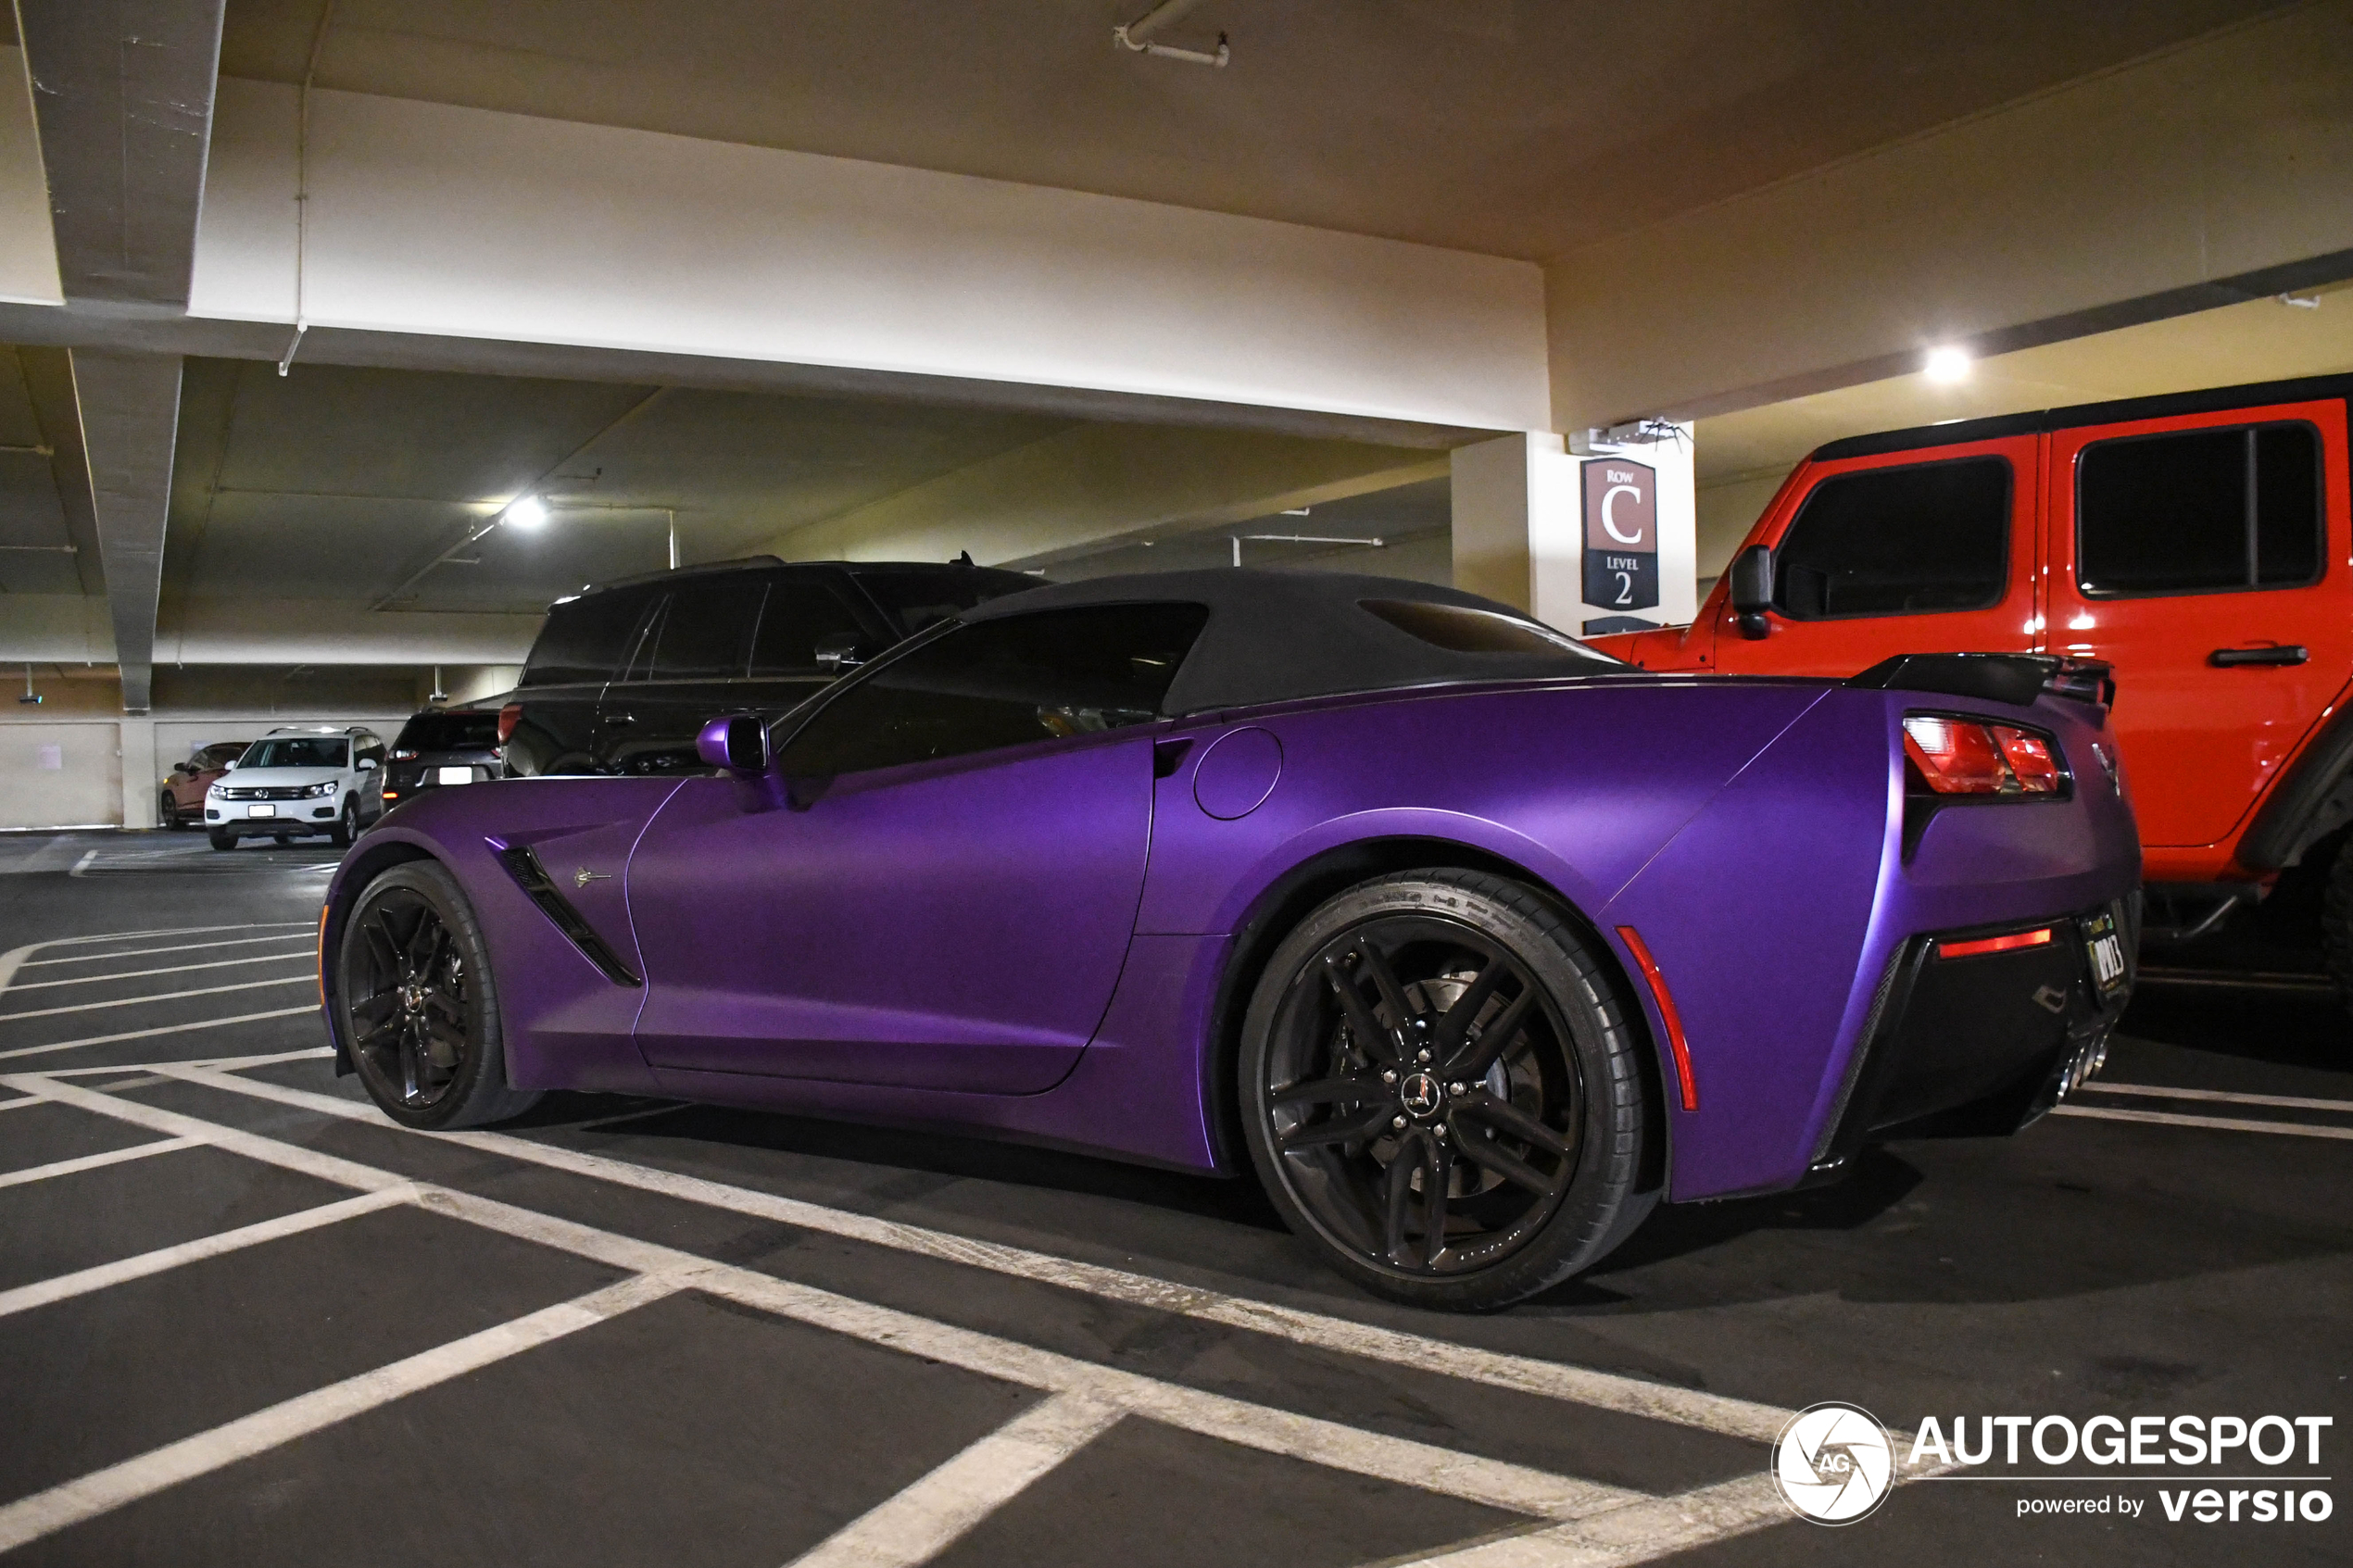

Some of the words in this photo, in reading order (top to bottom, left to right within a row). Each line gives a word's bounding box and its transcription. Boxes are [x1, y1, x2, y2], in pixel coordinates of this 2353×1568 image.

[1606, 470, 1634, 483] ROW
[1601, 484, 1642, 544] C
[1606, 556, 1639, 571] LEVEL
[1615, 571, 1632, 605] 2
